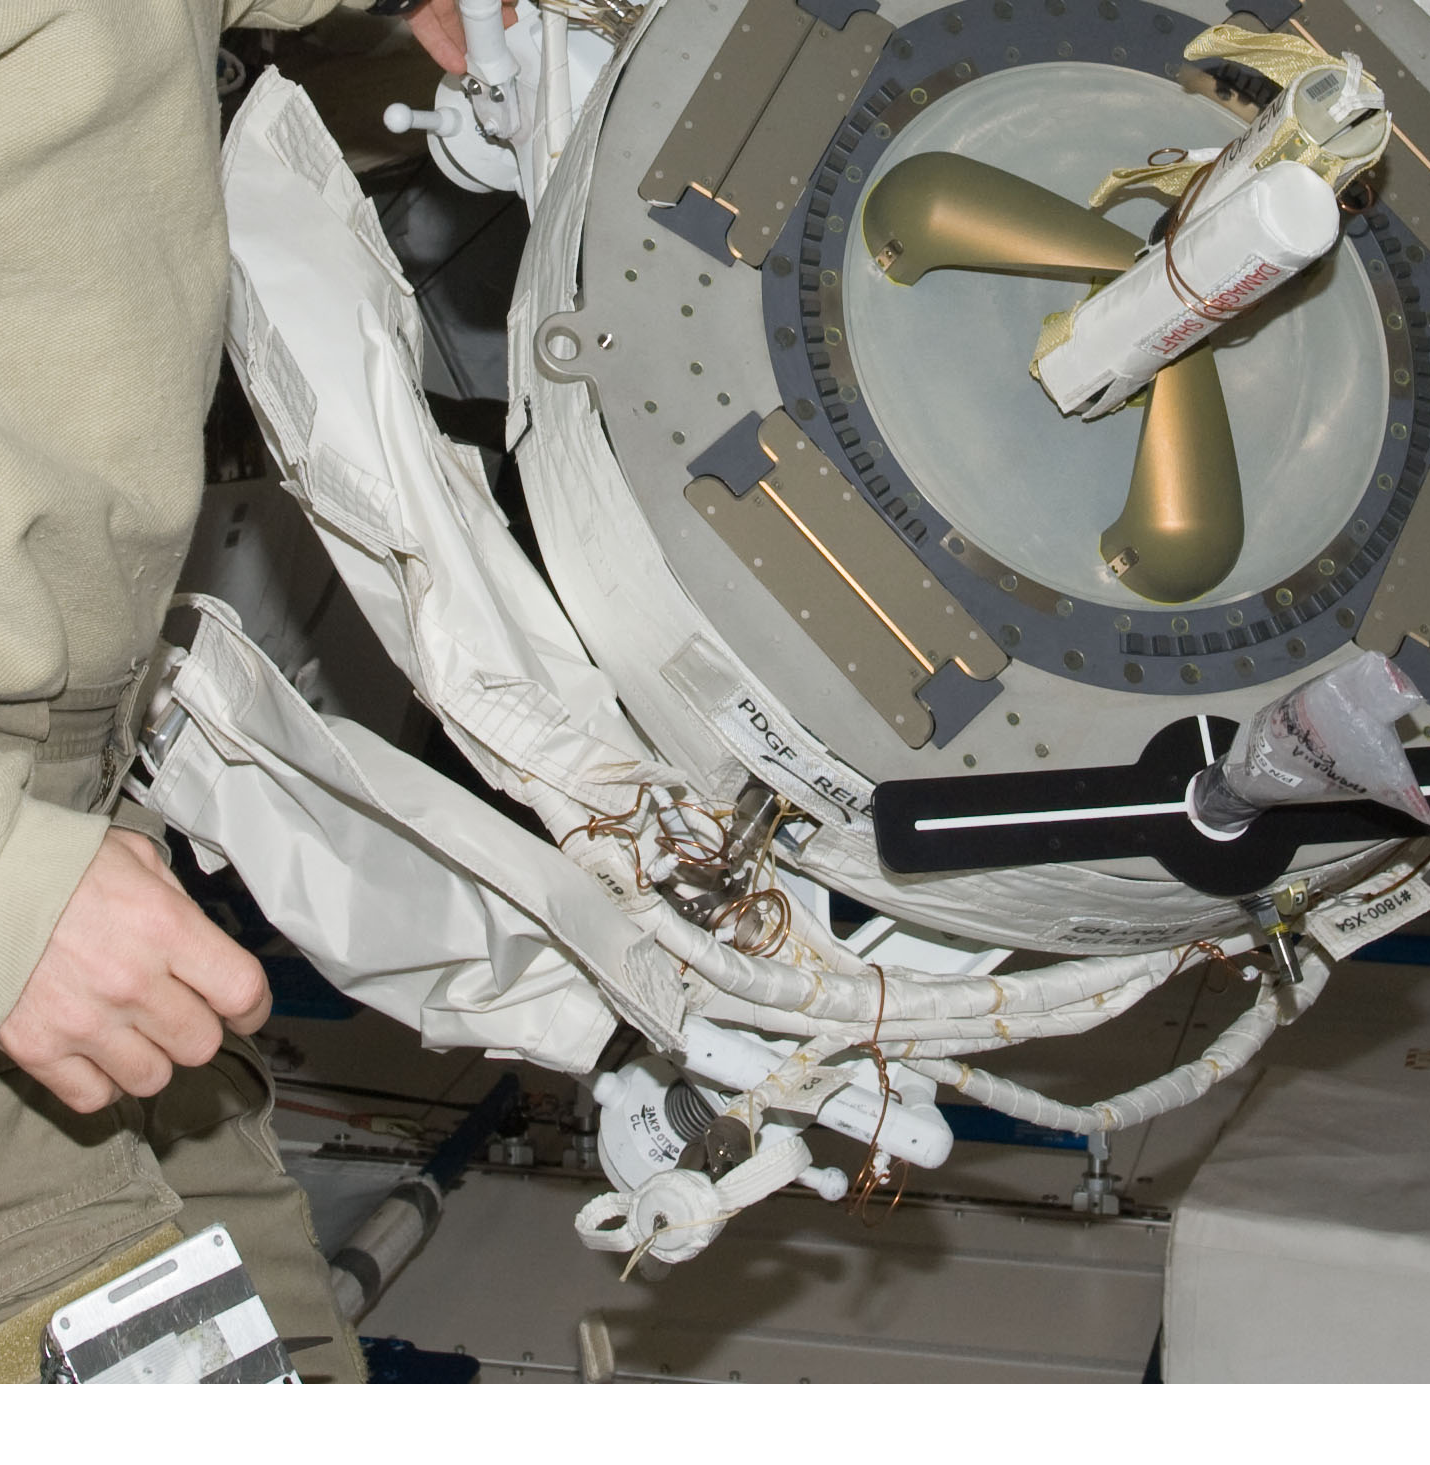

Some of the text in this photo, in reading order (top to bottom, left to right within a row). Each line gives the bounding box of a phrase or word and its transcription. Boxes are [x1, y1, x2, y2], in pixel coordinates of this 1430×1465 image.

[1221, 87, 1288, 169] TOP END
[1152, 262, 1283, 356] DAMAGED SHAFT
[738, 698, 798, 761] PDGF
[596, 871, 624, 896] J19
